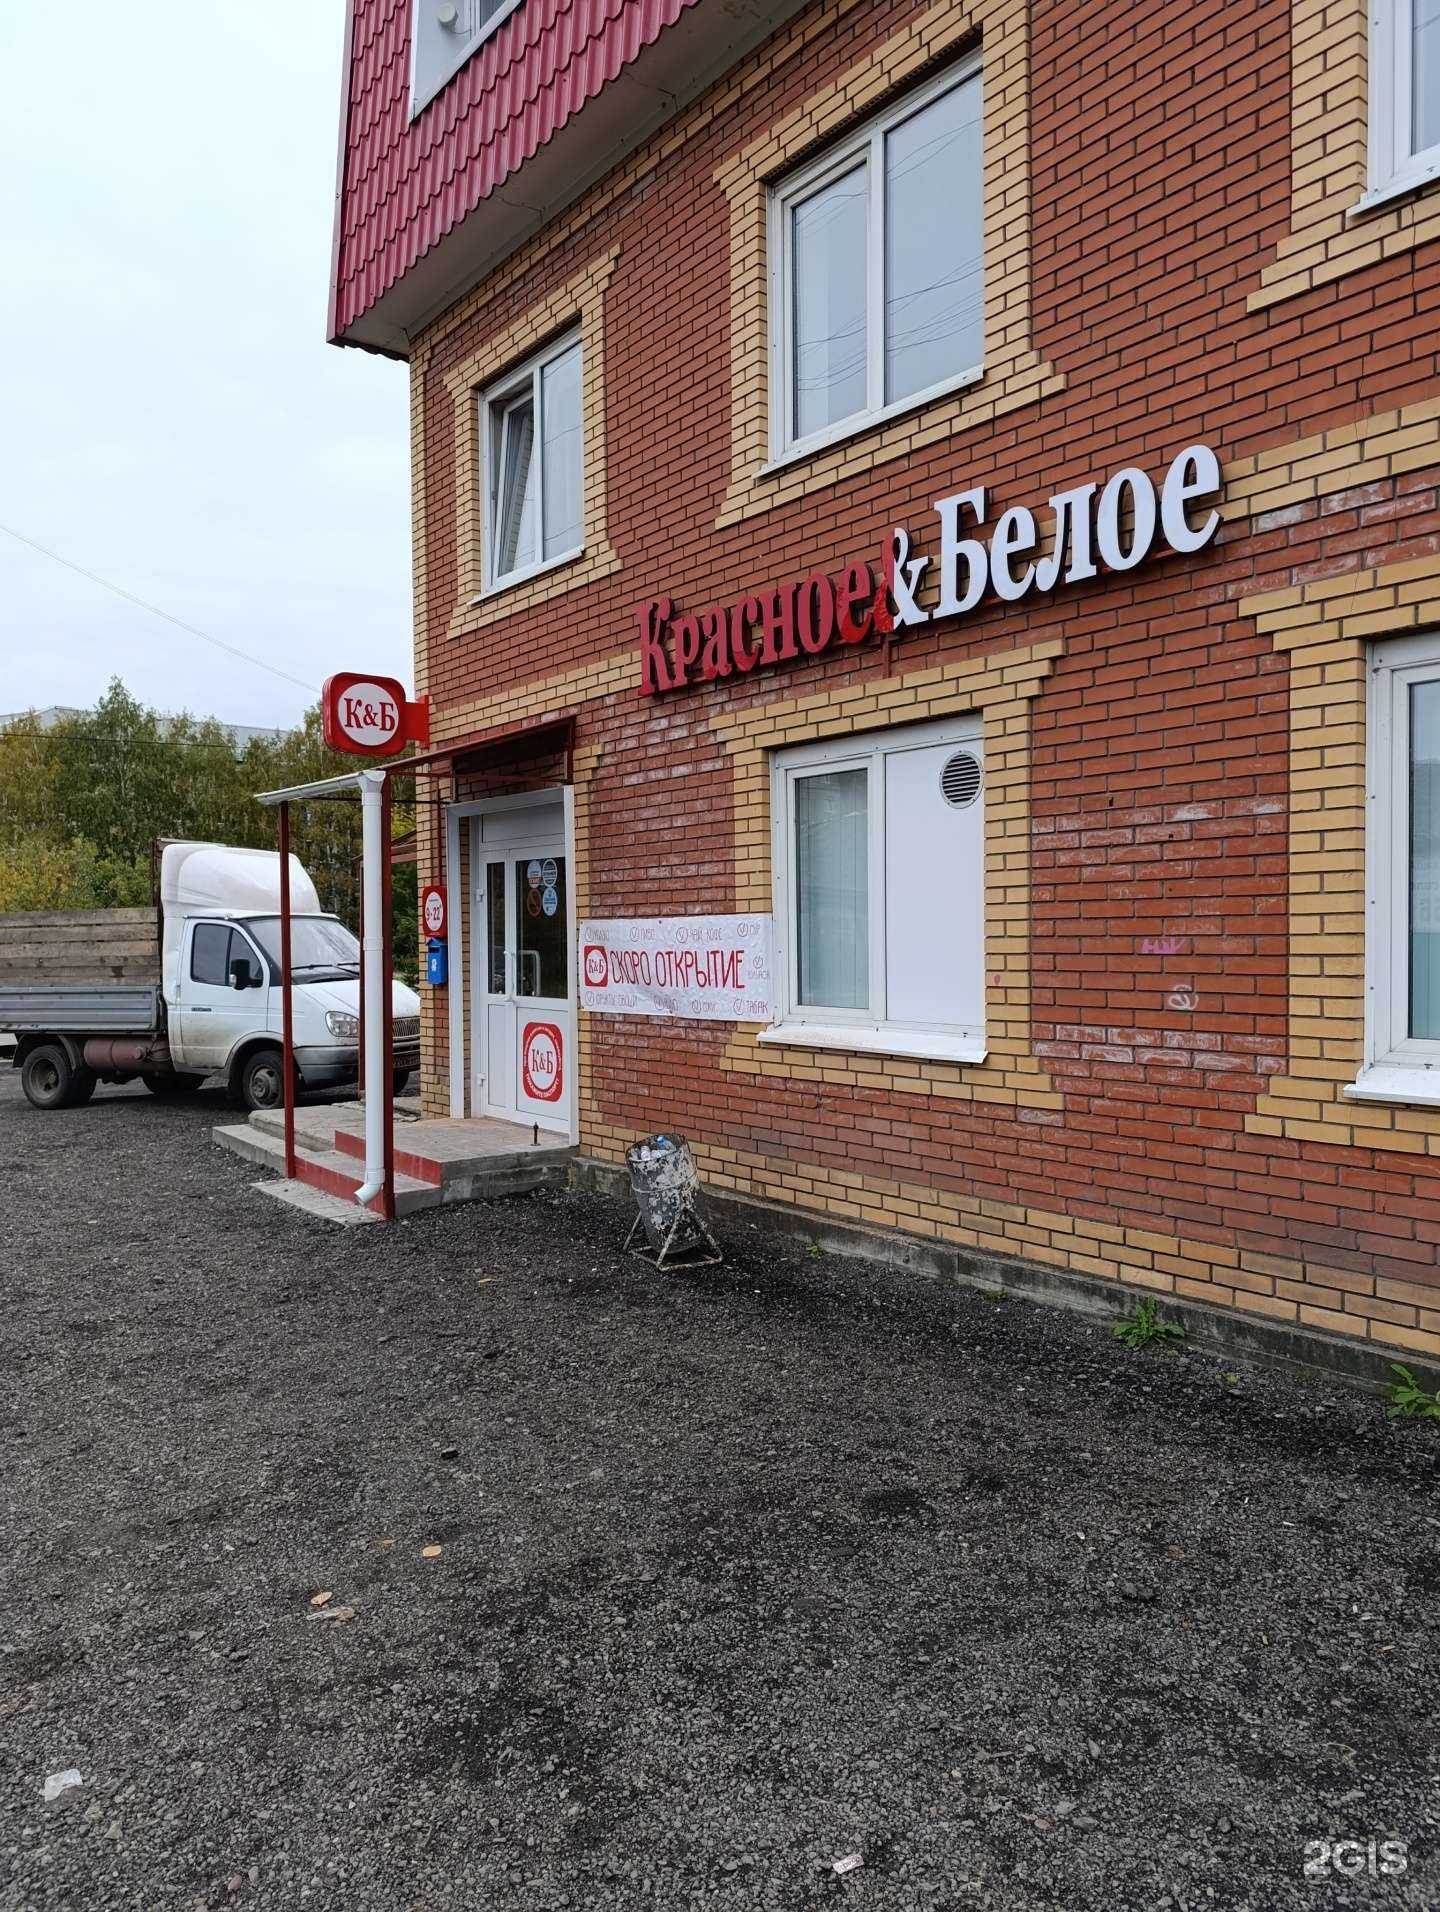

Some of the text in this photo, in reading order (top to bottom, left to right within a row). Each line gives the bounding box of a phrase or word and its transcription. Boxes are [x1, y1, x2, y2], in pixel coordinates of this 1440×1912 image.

[637, 444, 1223, 698] Красное&Белое
[344, 698, 396, 732] К&Б
[588, 958, 604, 974] К&Б
[610, 950, 745, 989] СКОРО ОТКРЫТИЕ
[532, 1049, 553, 1074] К&Б
